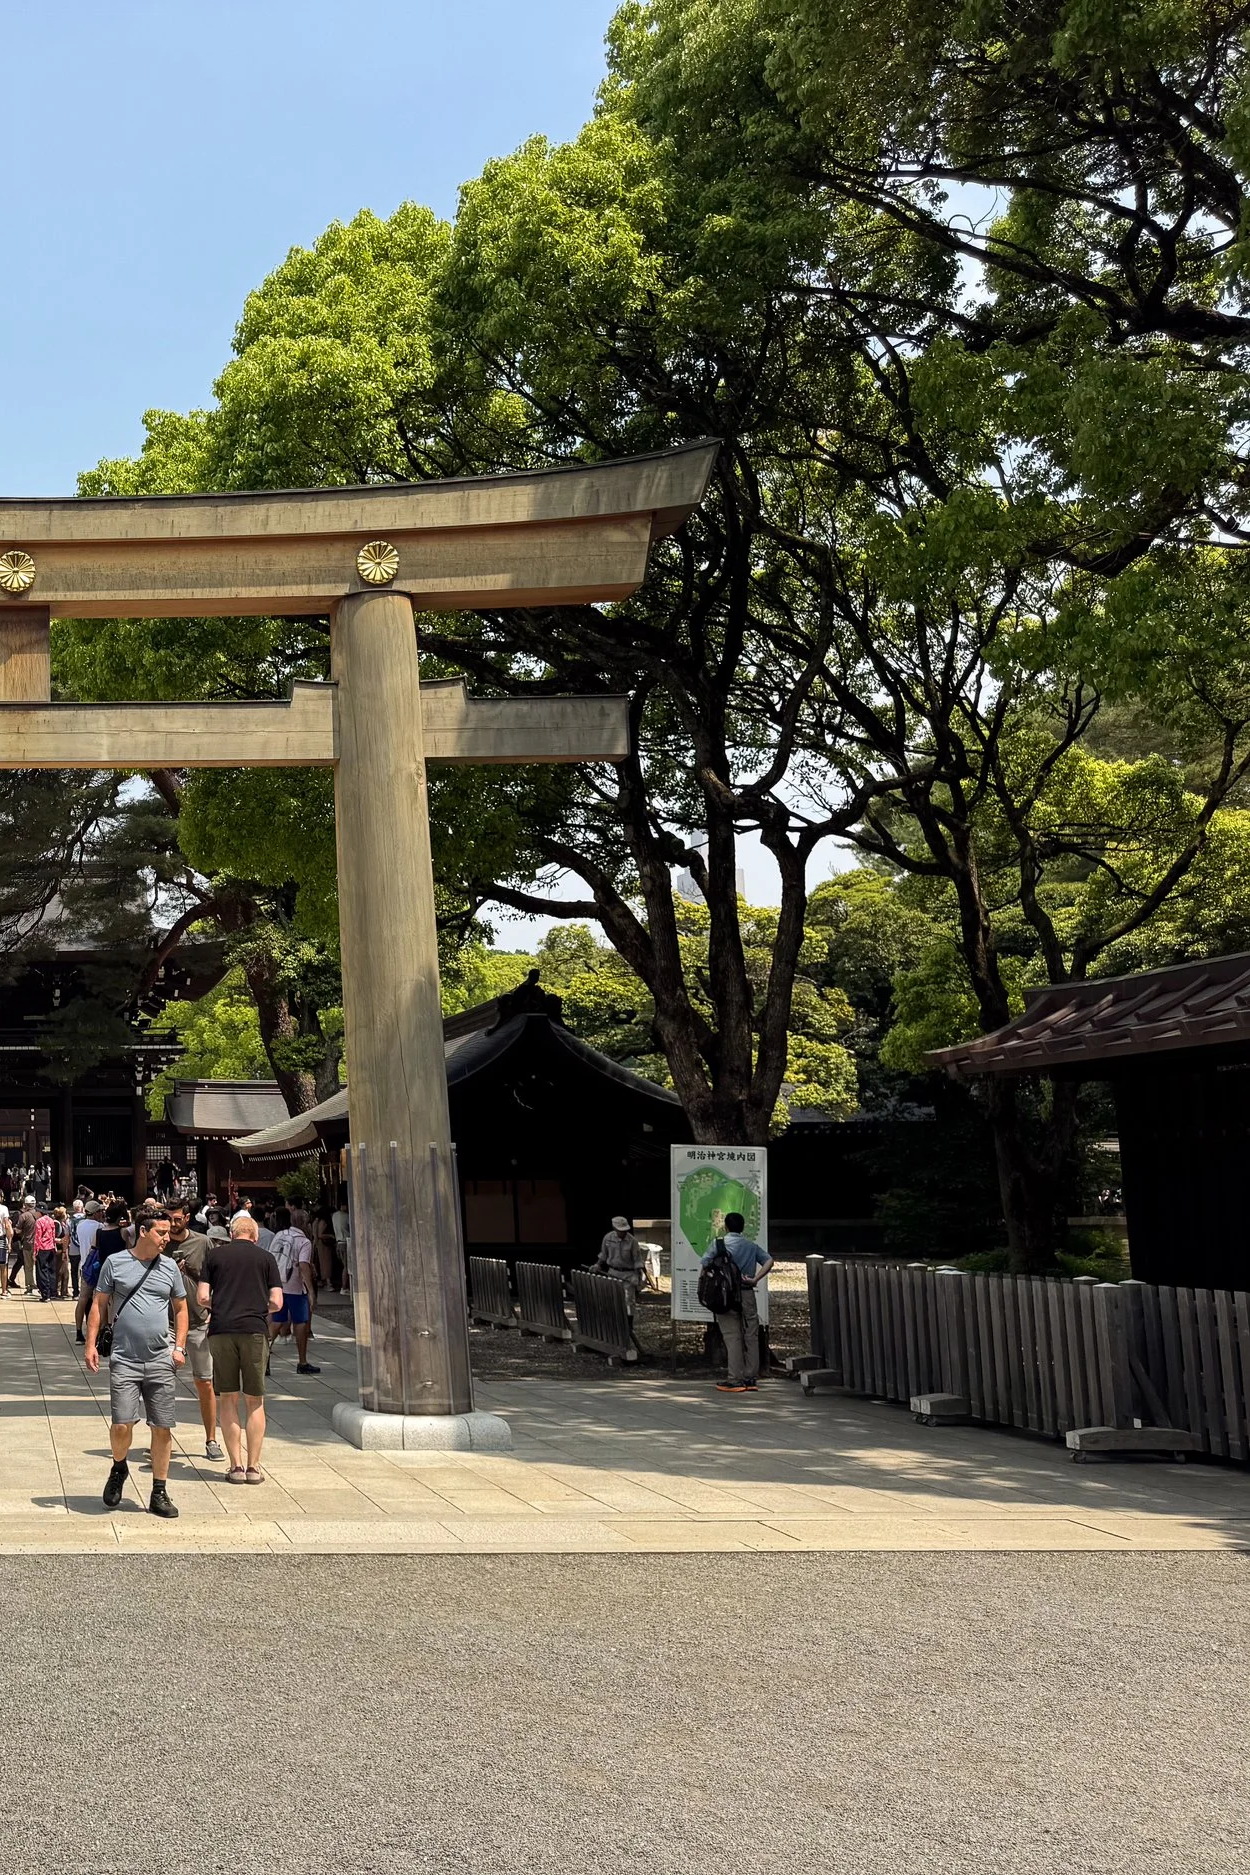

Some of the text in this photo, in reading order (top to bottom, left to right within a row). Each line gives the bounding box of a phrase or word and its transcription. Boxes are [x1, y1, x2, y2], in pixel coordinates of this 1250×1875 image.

[686, 1150, 756, 1161] 明治神宮境内図
